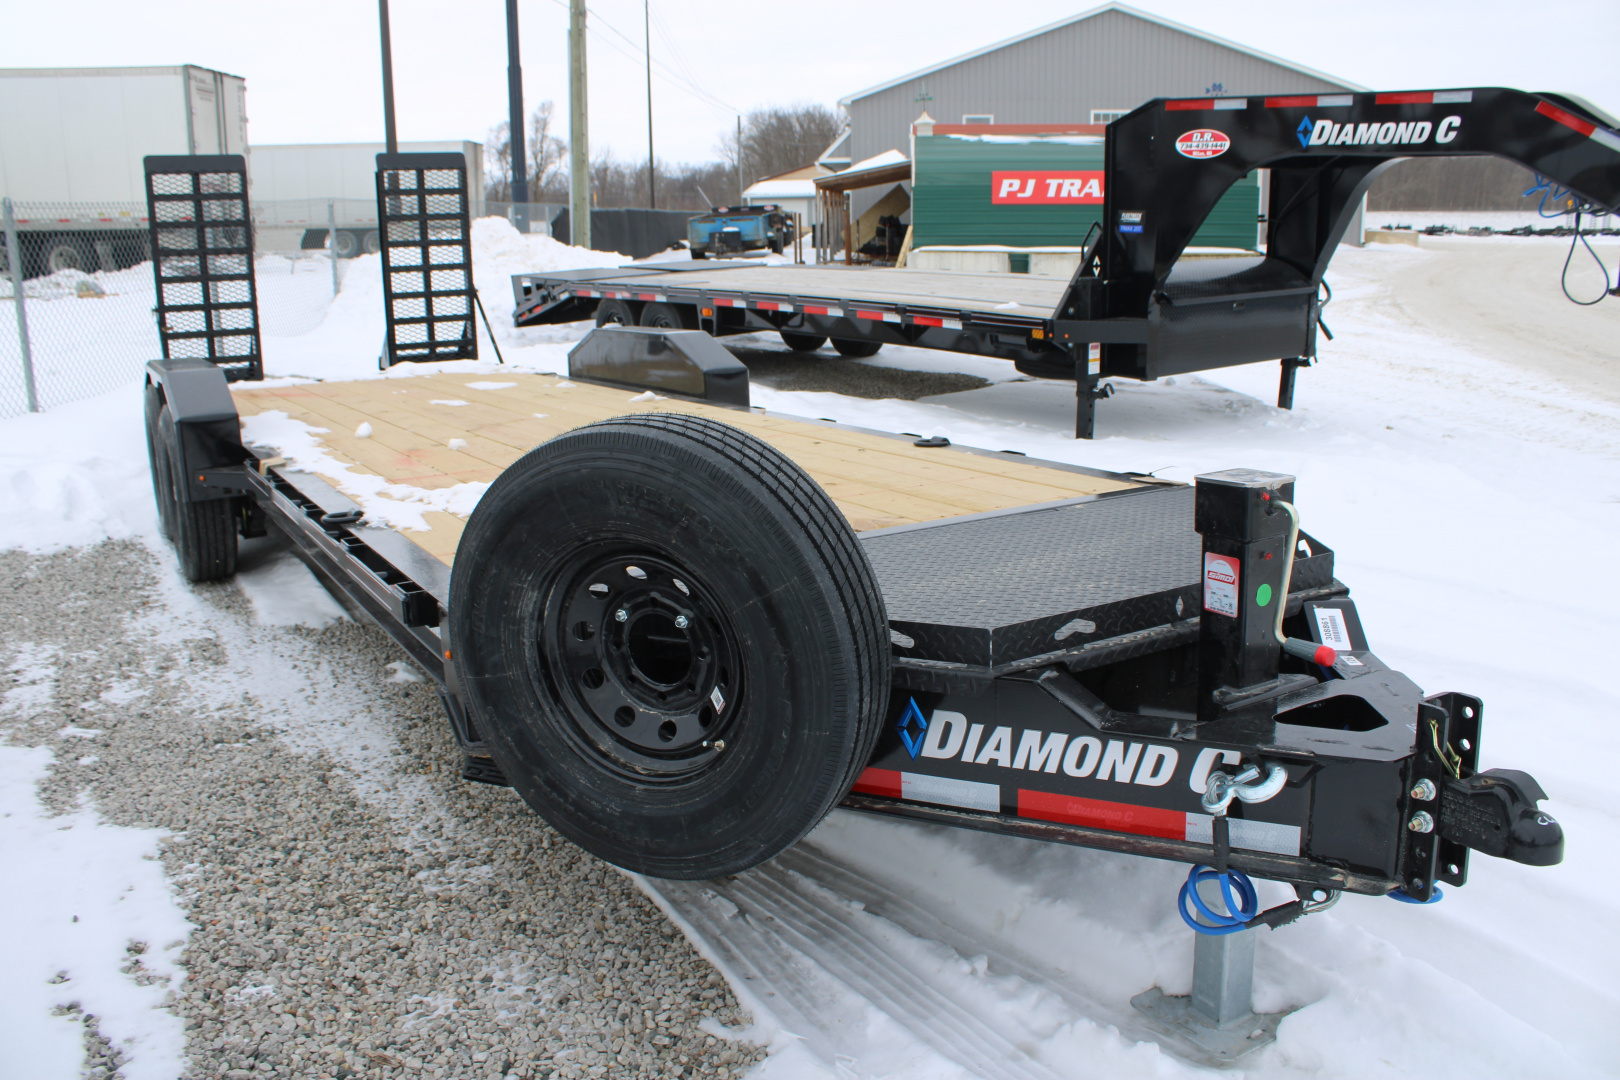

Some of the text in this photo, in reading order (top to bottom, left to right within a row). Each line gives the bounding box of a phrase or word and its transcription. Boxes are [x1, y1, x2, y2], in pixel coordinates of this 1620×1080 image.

[1192, 132, 1215, 142] D.R.
[1308, 115, 1462, 146] DIAMOND C
[999, 179, 1105, 198] PJ TRA
[921, 708, 1179, 787] DIAMOND
